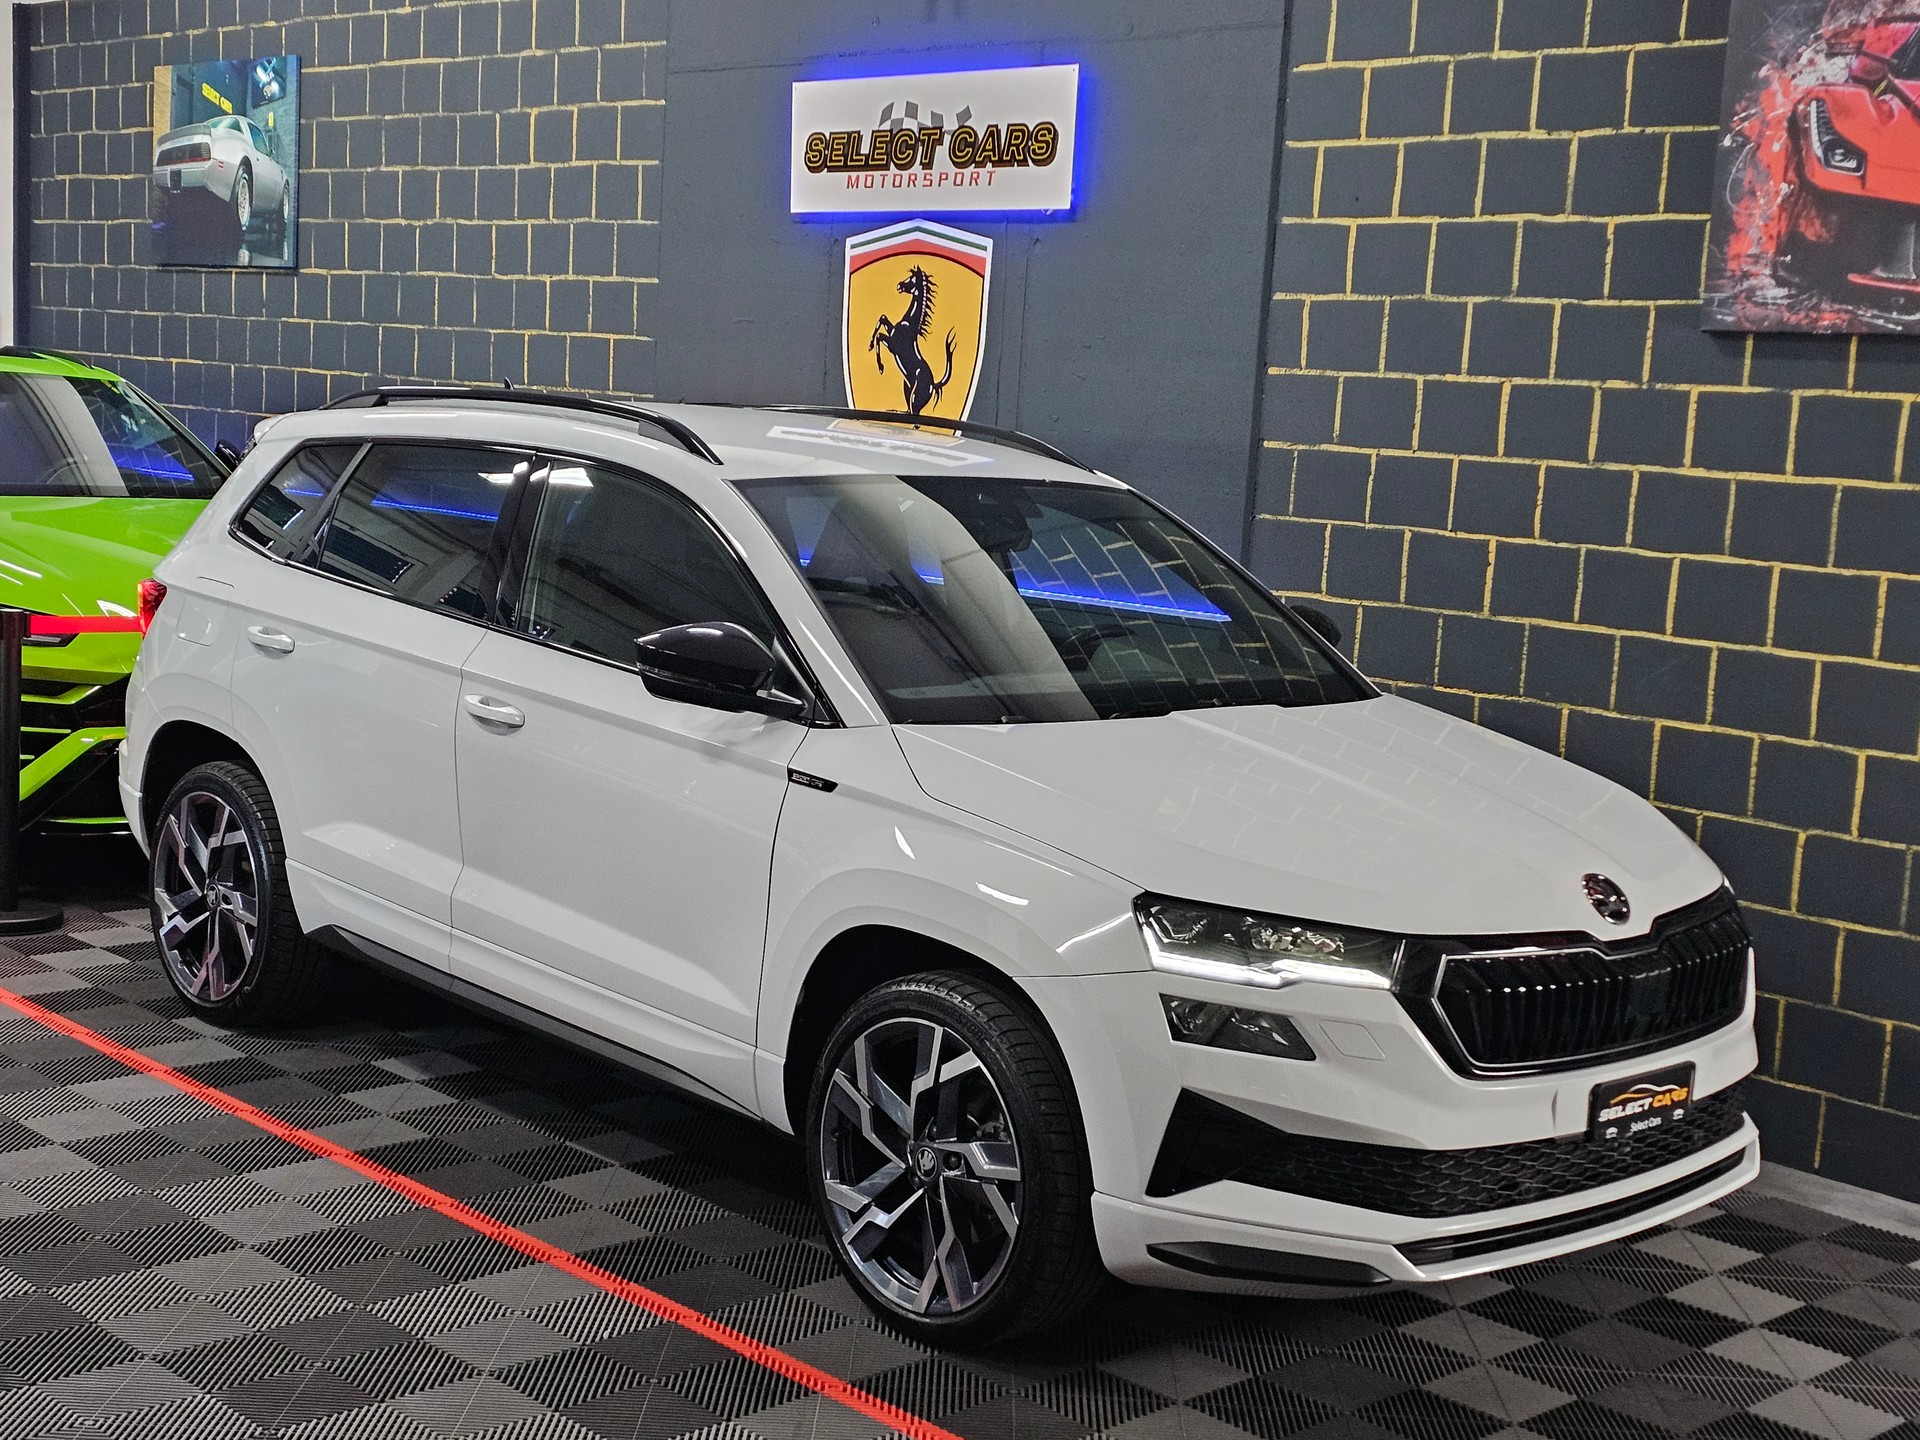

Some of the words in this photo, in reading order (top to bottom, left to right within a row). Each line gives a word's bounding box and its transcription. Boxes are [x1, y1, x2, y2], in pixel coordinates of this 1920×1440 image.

[804, 126, 944, 173] SELECT
[948, 121, 1059, 170] CARS
[846, 170, 996, 189] MOTORSPORT
